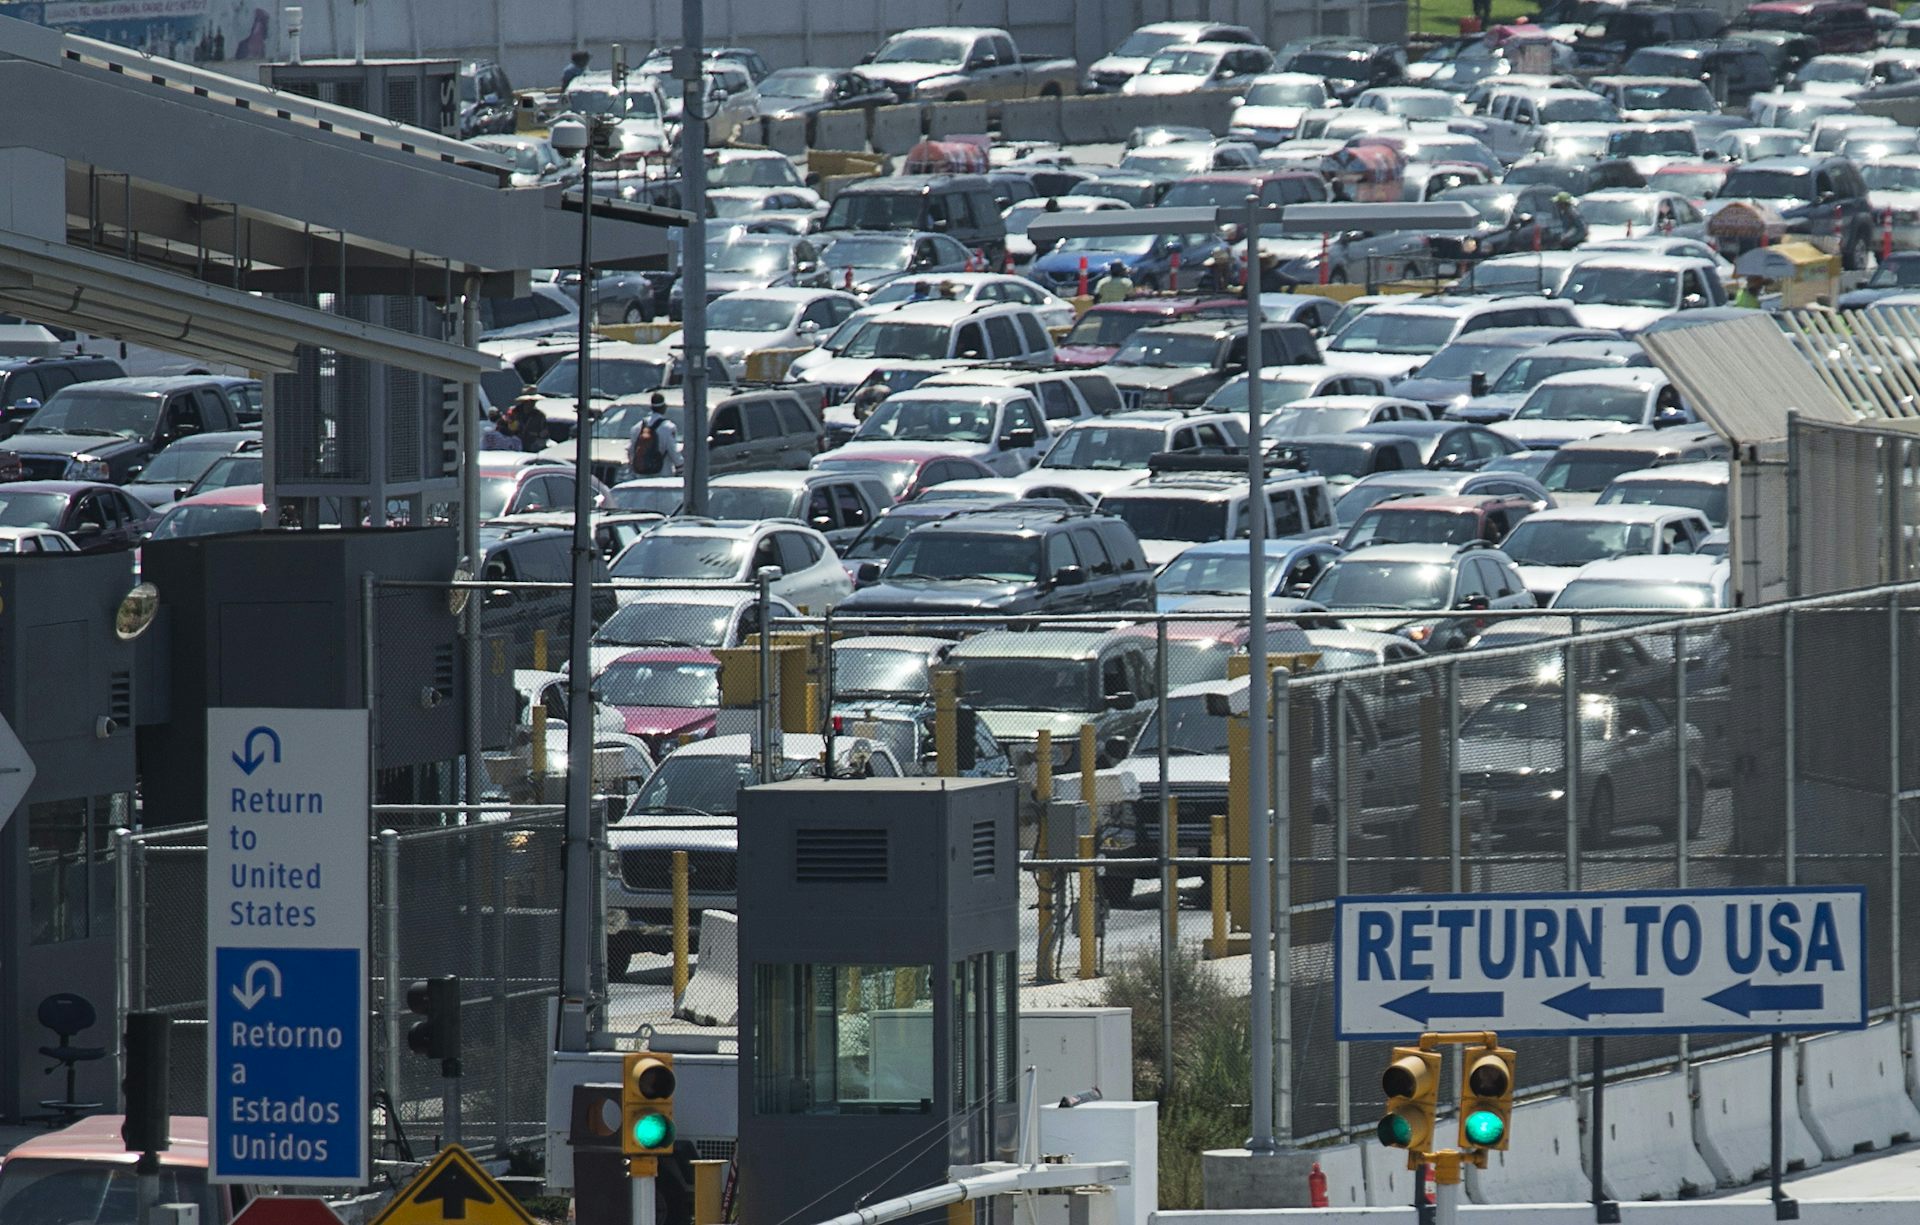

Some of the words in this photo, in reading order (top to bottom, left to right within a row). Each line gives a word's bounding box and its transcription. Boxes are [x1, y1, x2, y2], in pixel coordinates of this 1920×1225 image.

[231, 787, 323, 814] Return
[230, 825, 257, 851] to
[231, 862, 321, 889] United
[230, 900, 316, 928] States
[1357, 905, 1602, 982] RETURN
[1624, 904, 1702, 977] TO
[1725, 901, 1845, 976] USA
[232, 1021, 342, 1049] Retorno
[231, 1062, 247, 1085] a
[232, 1096, 340, 1123] Estados
[232, 1133, 328, 1161] Unidos
